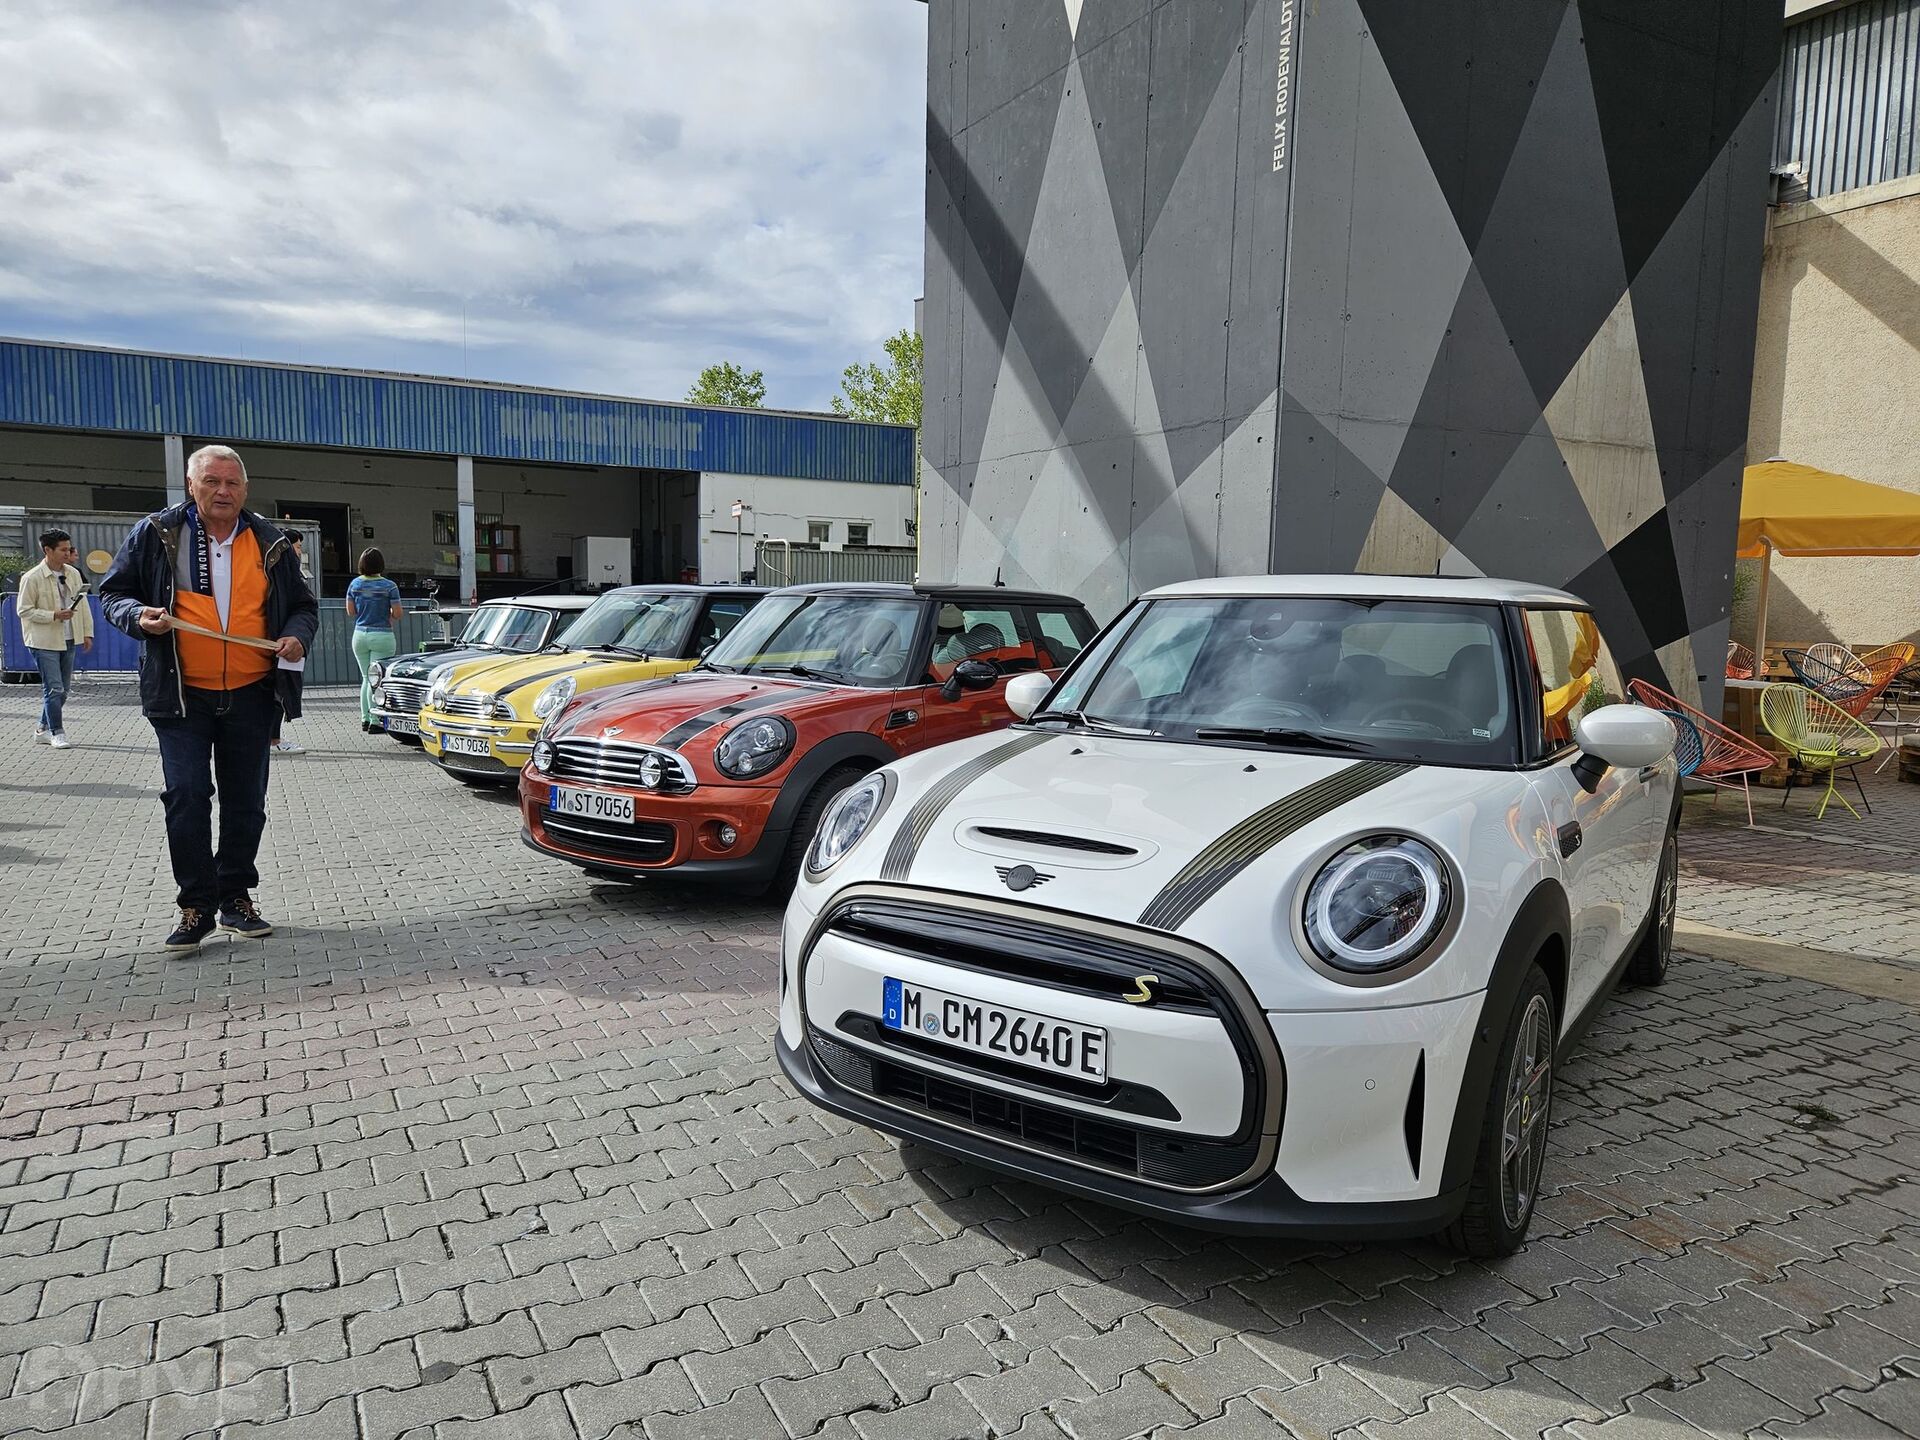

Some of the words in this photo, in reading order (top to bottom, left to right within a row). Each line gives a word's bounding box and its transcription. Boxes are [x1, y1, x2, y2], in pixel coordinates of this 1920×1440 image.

[1275, 1, 1294, 117] RODEWALDT
[1273, 118, 1287, 172] FELIX
[454, 737, 465, 751] ST
[466, 738, 490, 754] 9036
[558, 789, 566, 809] M
[574, 793, 592, 813] ST
[595, 796, 632, 819] 9056
[1122, 975, 1160, 1004] S
[889, 1009, 897, 1020] D
[903, 988, 921, 1029] M
